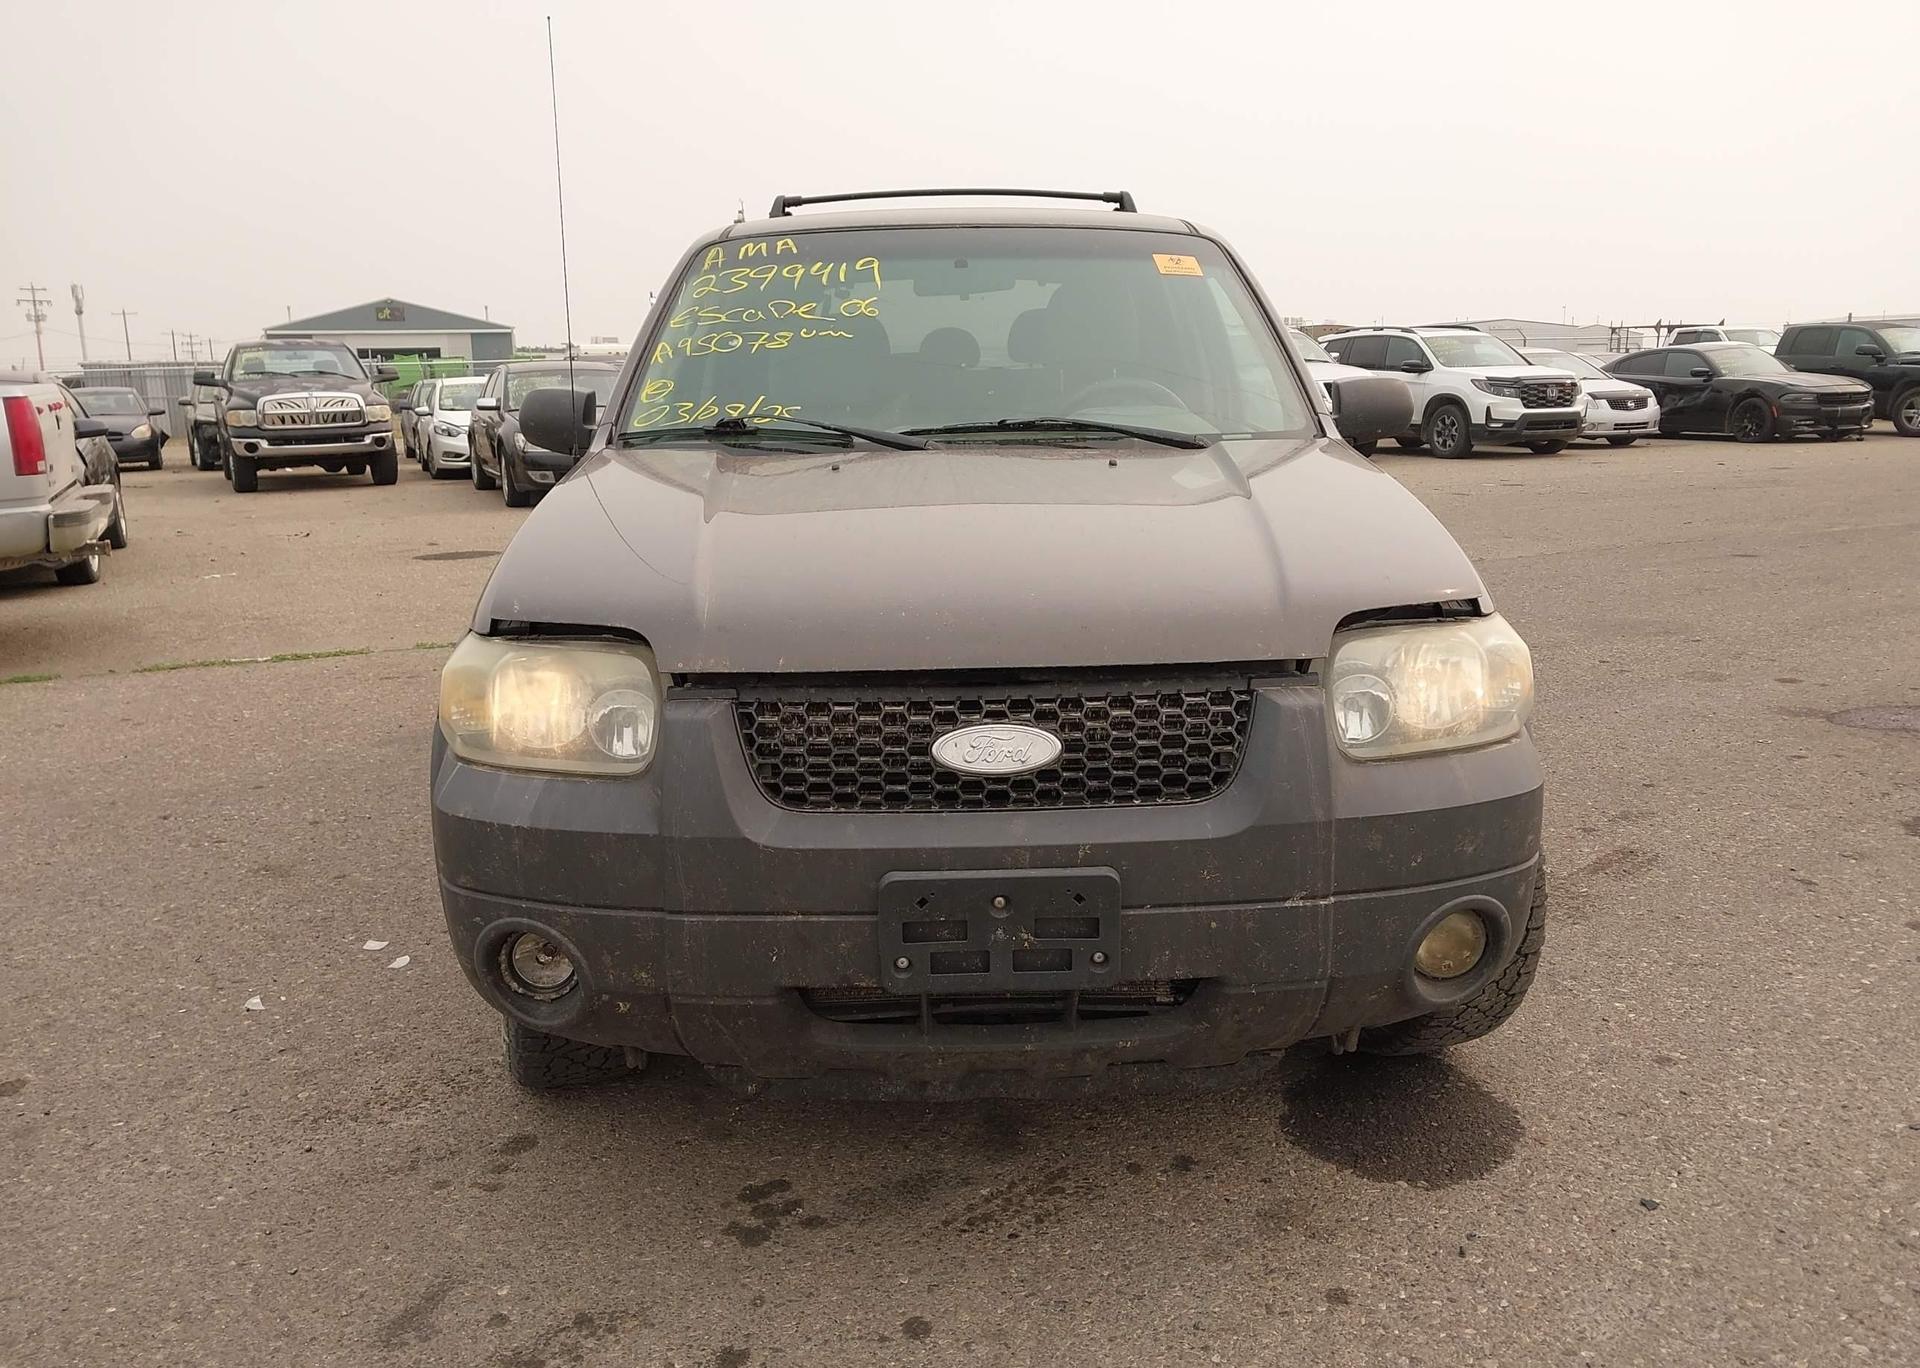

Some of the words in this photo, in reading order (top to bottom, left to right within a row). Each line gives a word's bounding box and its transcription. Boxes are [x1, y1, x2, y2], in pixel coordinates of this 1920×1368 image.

[692, 257, 881, 298] 2399419
[841, 296, 879, 317] 06
[962, 735, 1033, 764] Ford
